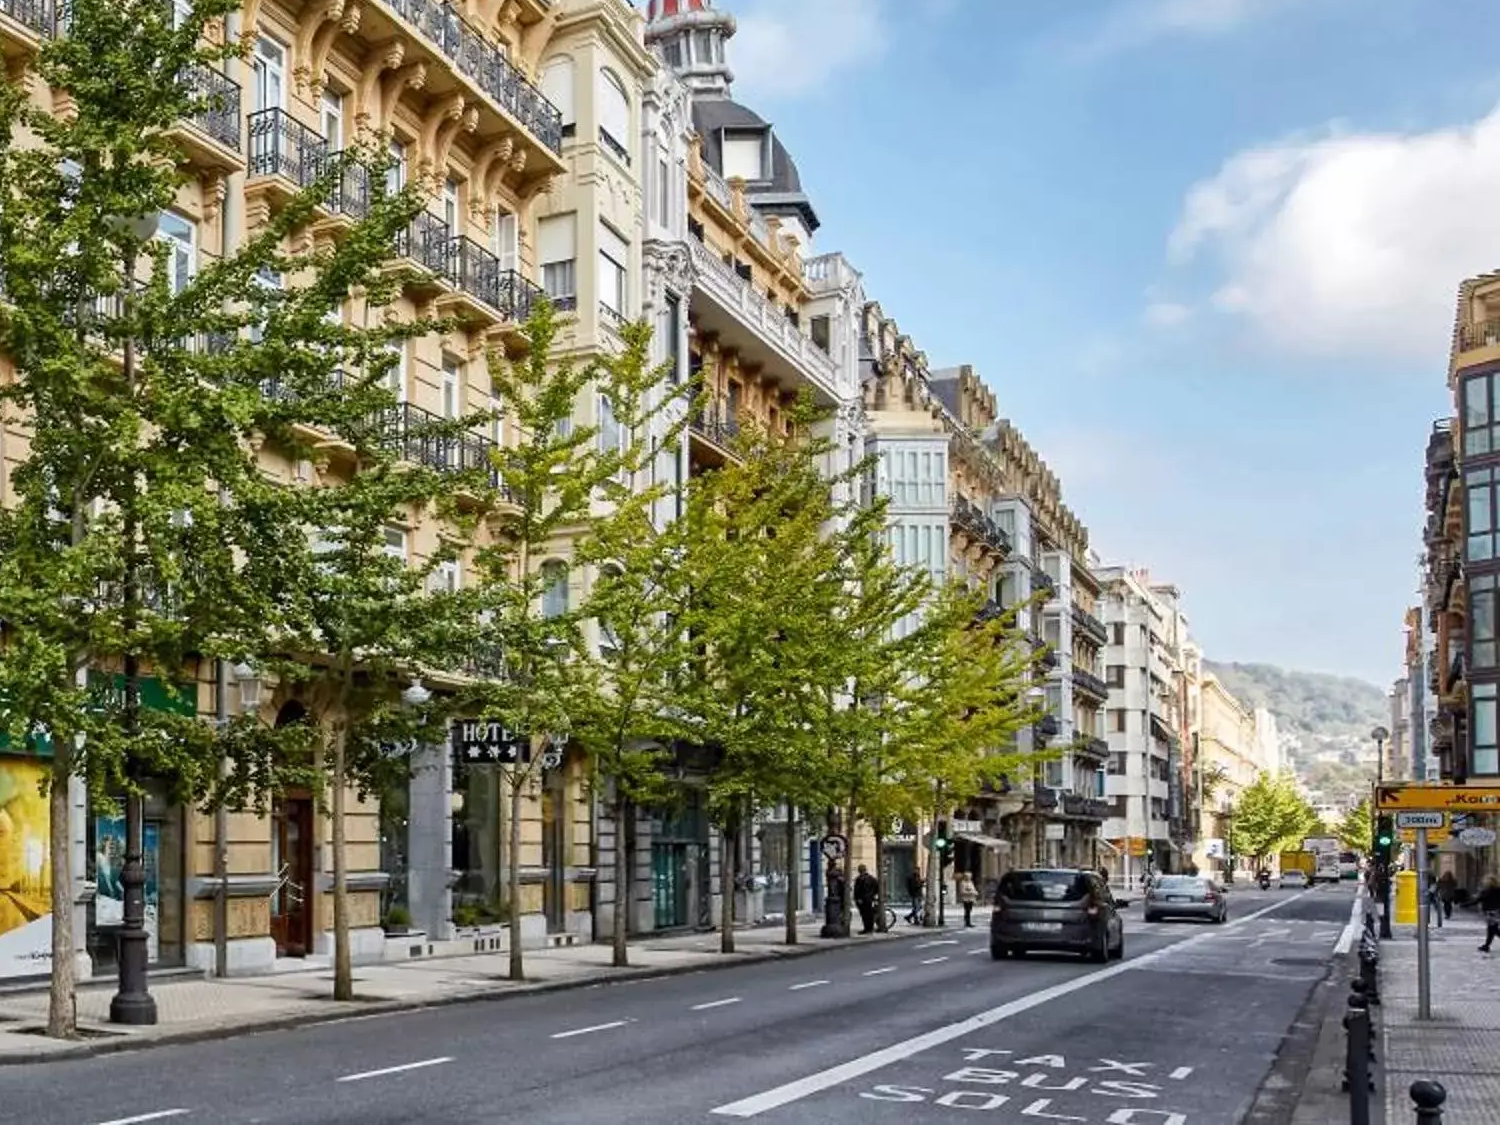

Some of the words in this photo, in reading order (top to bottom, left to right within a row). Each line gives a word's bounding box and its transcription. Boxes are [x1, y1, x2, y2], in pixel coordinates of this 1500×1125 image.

[463, 722, 515, 742] HOTE
[962, 1047, 1194, 1080] TAXI
[942, 1066, 1164, 1099] BUS
[858, 1083, 1189, 1125] SOLO
